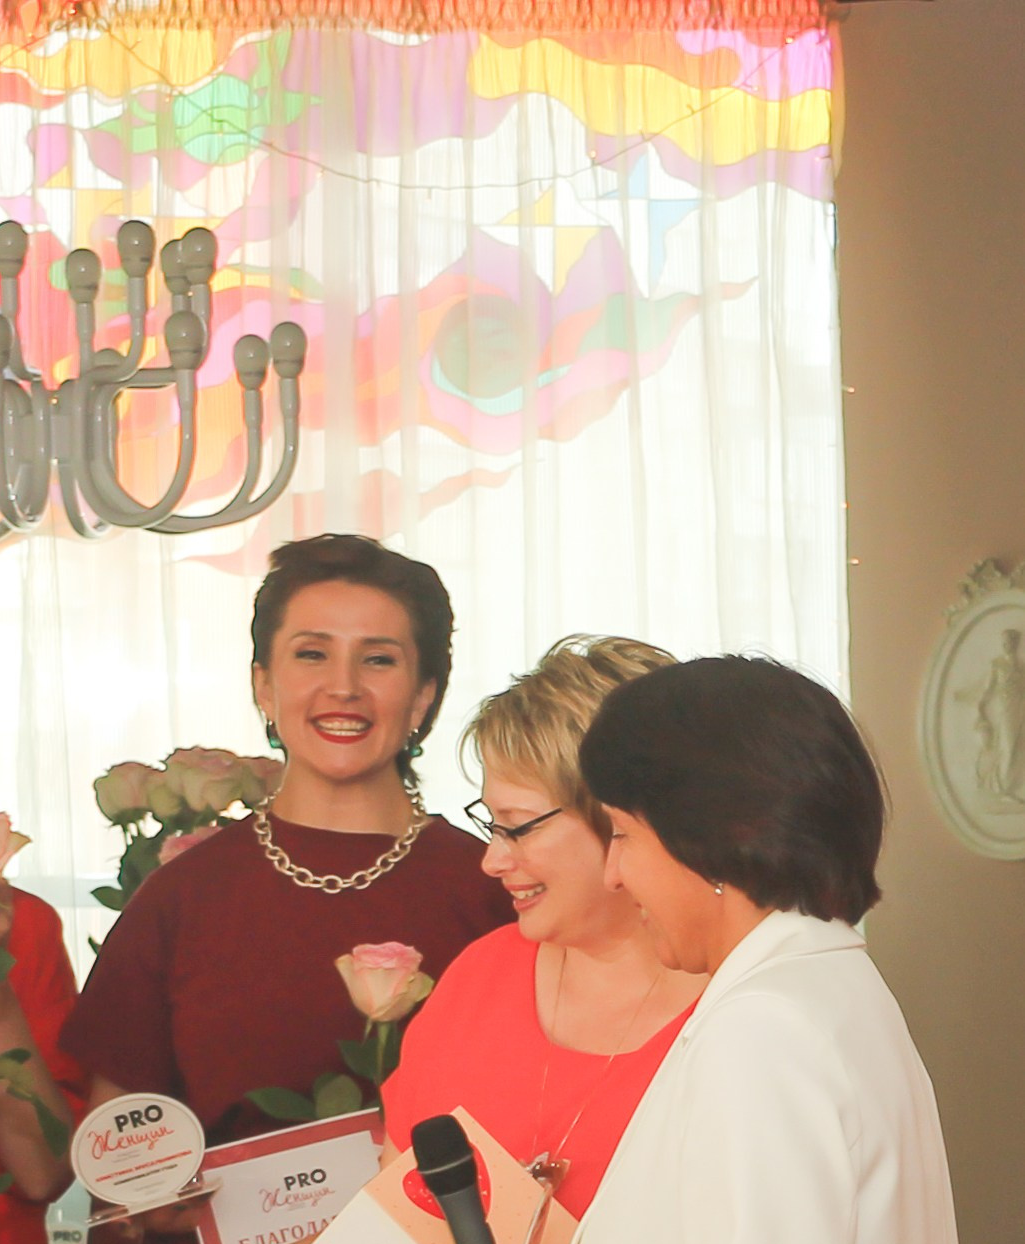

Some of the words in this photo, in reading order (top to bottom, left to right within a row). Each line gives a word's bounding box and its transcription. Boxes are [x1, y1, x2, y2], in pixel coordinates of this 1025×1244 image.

[114, 1104, 163, 1133] PRO
[88, 1127, 175, 1160] Женщин
[283, 1168, 327, 1191] PRO
[53, 1230, 82, 1243] PRO
